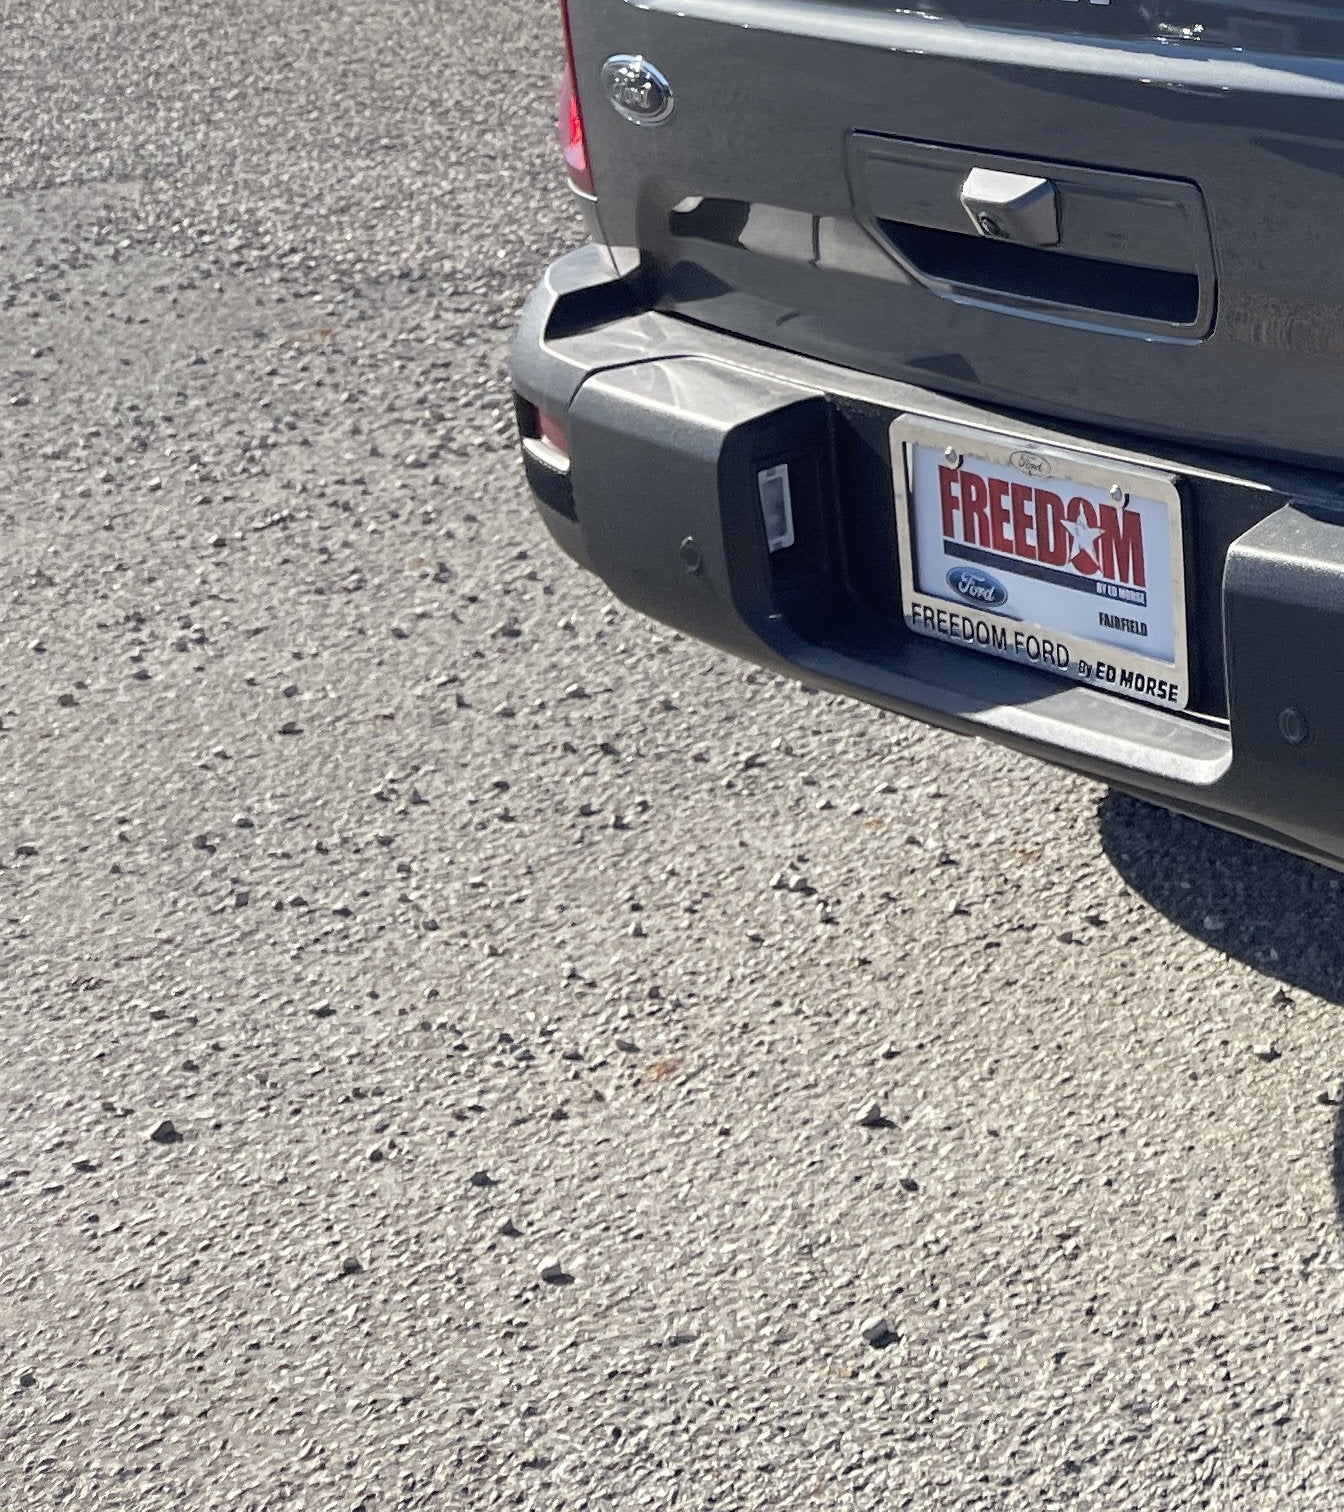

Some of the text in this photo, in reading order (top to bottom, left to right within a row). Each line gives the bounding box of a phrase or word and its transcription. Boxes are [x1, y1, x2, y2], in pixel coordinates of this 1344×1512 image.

[938, 464, 1146, 588] FREEDOM
[958, 573, 996, 601] Ford
[911, 602, 1007, 651] FREEDOM
[1014, 630, 1069, 668] FORD
[1095, 661, 1117, 683] ED
[1120, 668, 1179, 704] MORSE
[1099, 611, 1148, 637] FAIRFIELD
